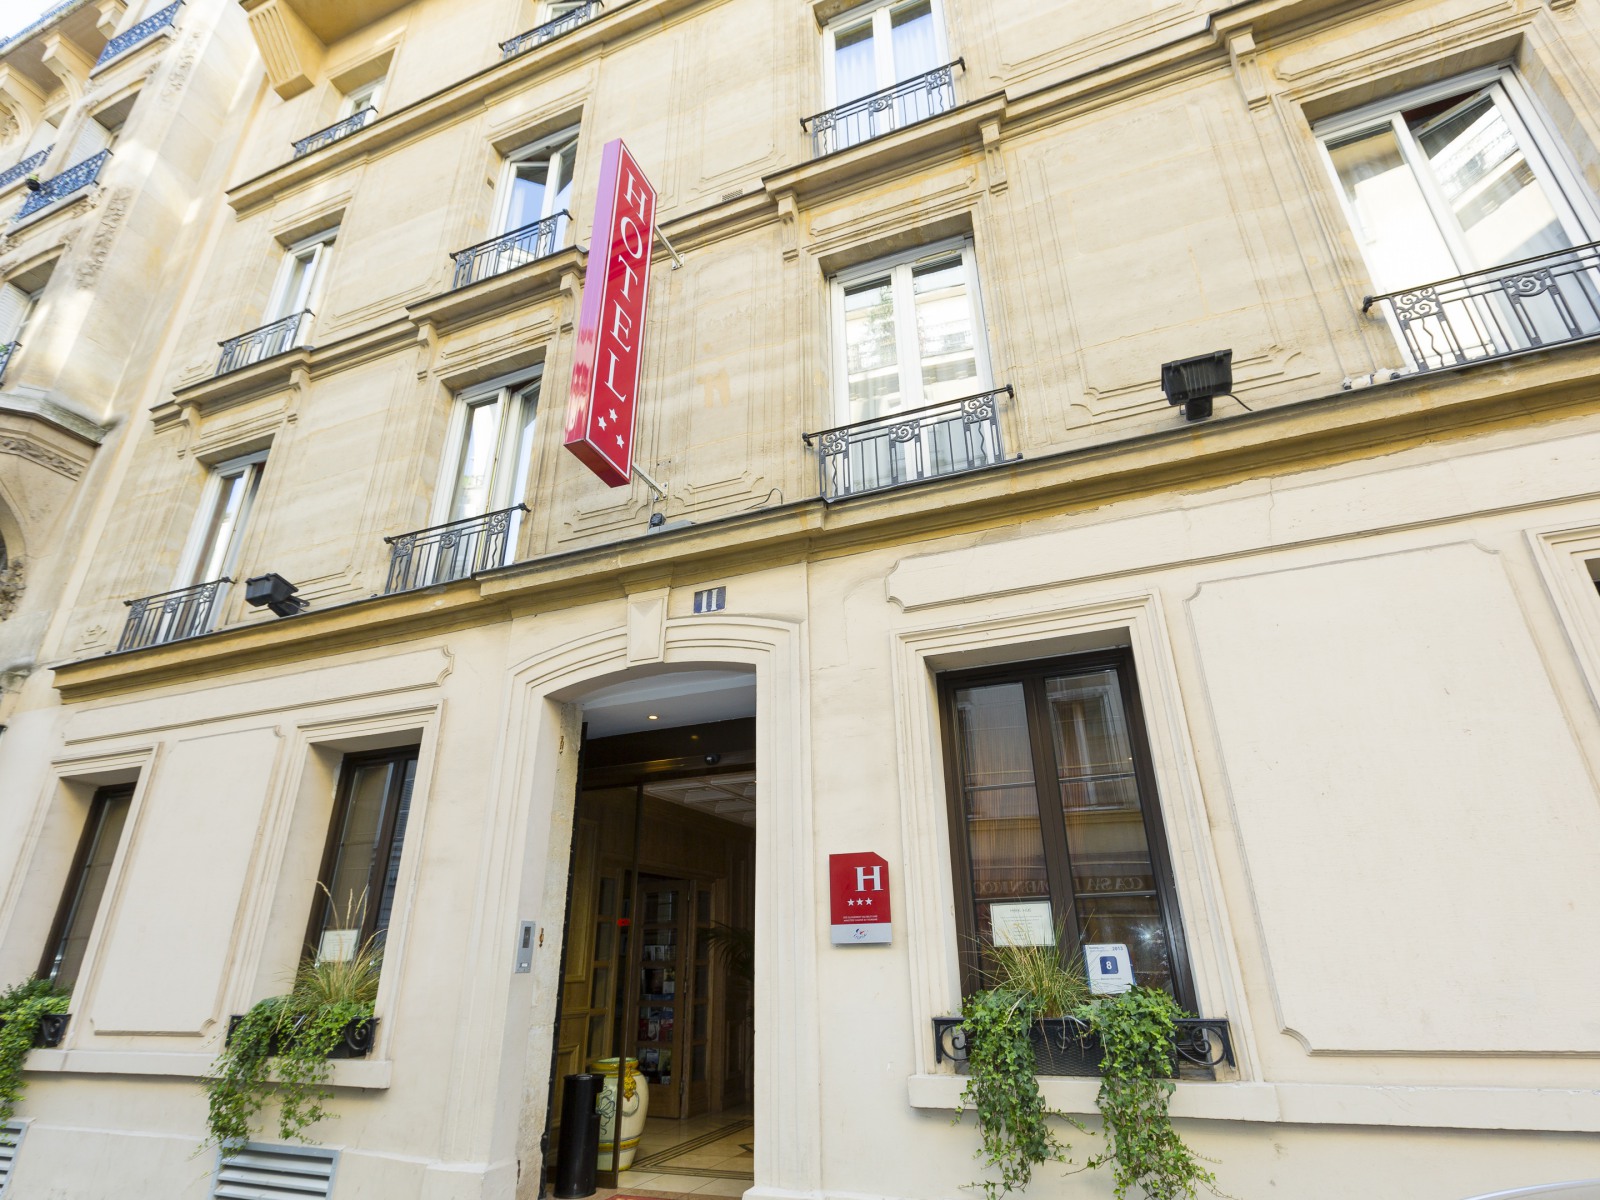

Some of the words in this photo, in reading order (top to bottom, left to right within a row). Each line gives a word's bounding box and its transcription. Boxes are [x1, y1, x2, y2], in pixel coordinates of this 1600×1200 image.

[605, 167, 648, 403] HOTEL
[854, 865, 884, 892] H
[1105, 960, 1113, 970] 8
